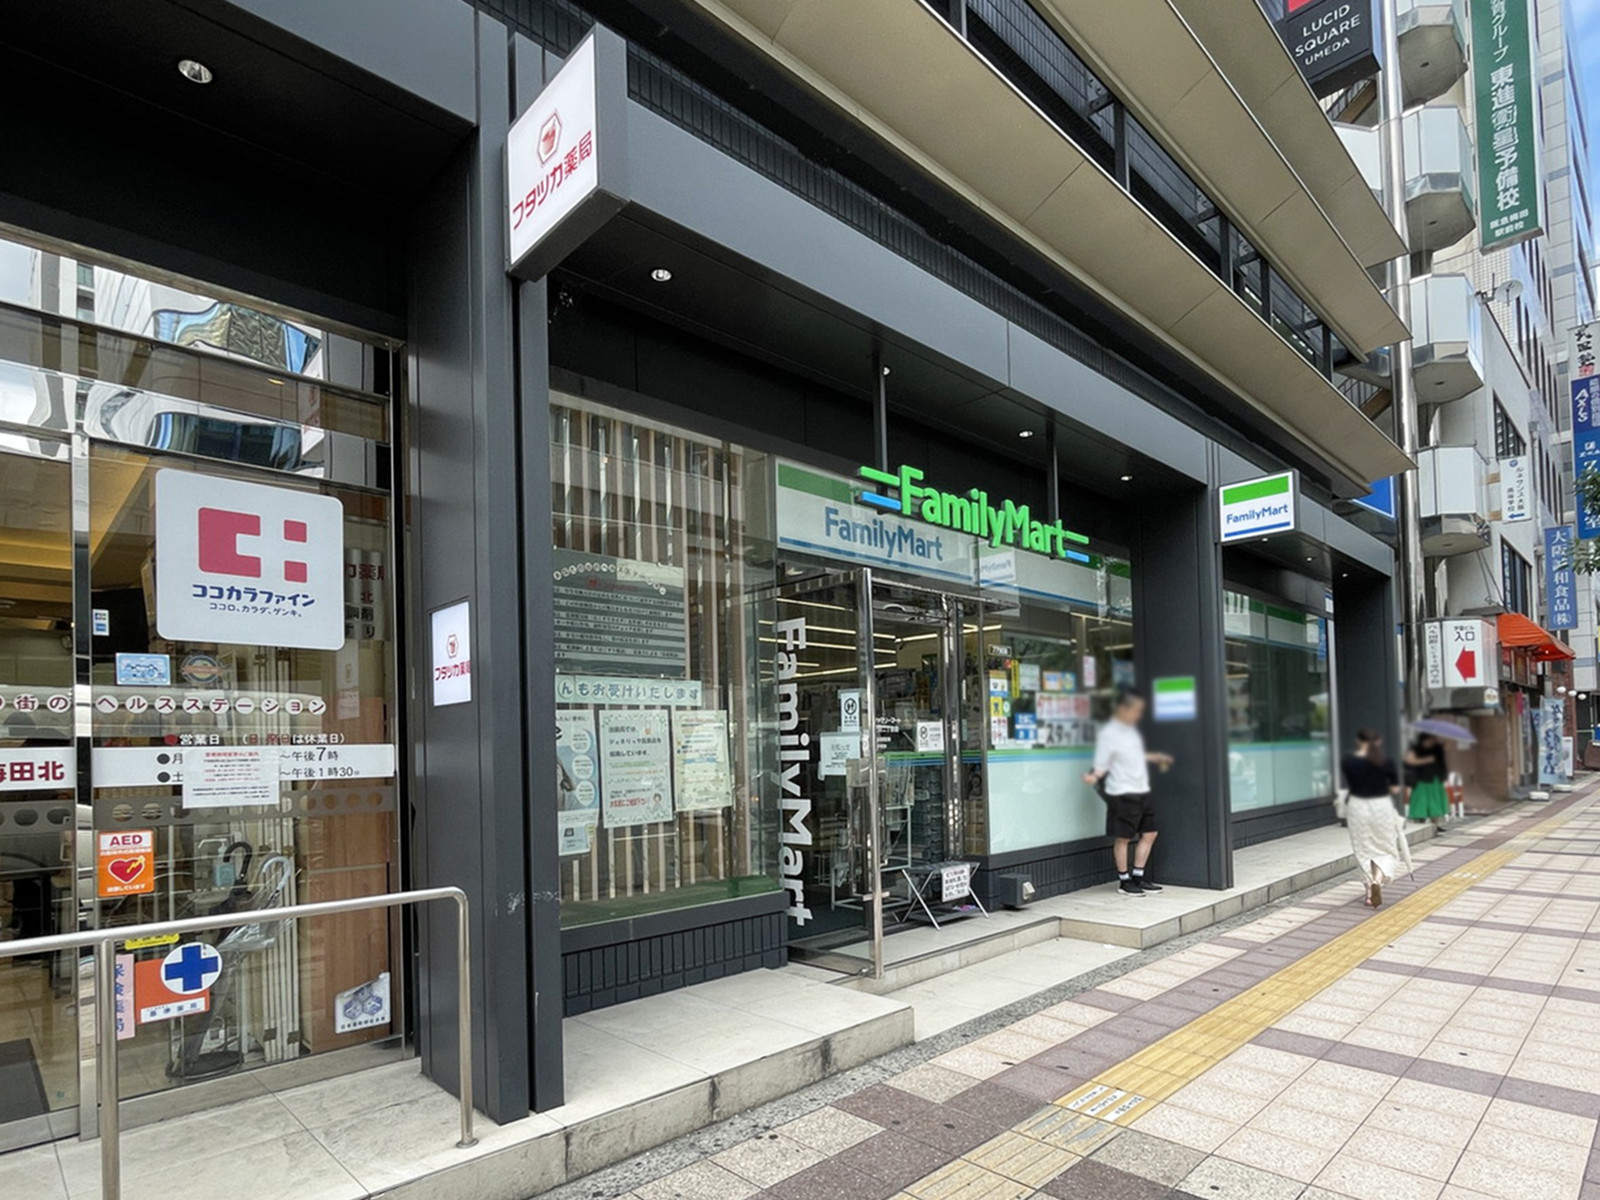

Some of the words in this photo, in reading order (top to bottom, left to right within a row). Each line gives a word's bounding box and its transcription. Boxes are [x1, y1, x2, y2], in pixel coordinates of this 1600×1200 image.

[1303, 4, 1350, 37] LUCID
[1295, 14, 1361, 57] SQUARE
[1304, 37, 1350, 65] UMEDA
[512, 130, 593, 230] フタツカ薬局
[899, 464, 1067, 558] FamilyMart
[1226, 504, 1289, 524] FamilyMart
[825, 506, 943, 561] FamilyMart
[192, 584, 316, 608] ココカラファイン
[1454, 631, 1476, 642] 入口
[561, 682, 700, 700] んもお受けいたします
[0, 696, 69, 711] 街の
[98, 696, 325, 713] ヘルスステーション
[180, 733, 220, 746] 営業日
[172, 753, 183, 765] 月
[771, 617, 812, 927] FamilyMart
[110, 834, 143, 847] AED
